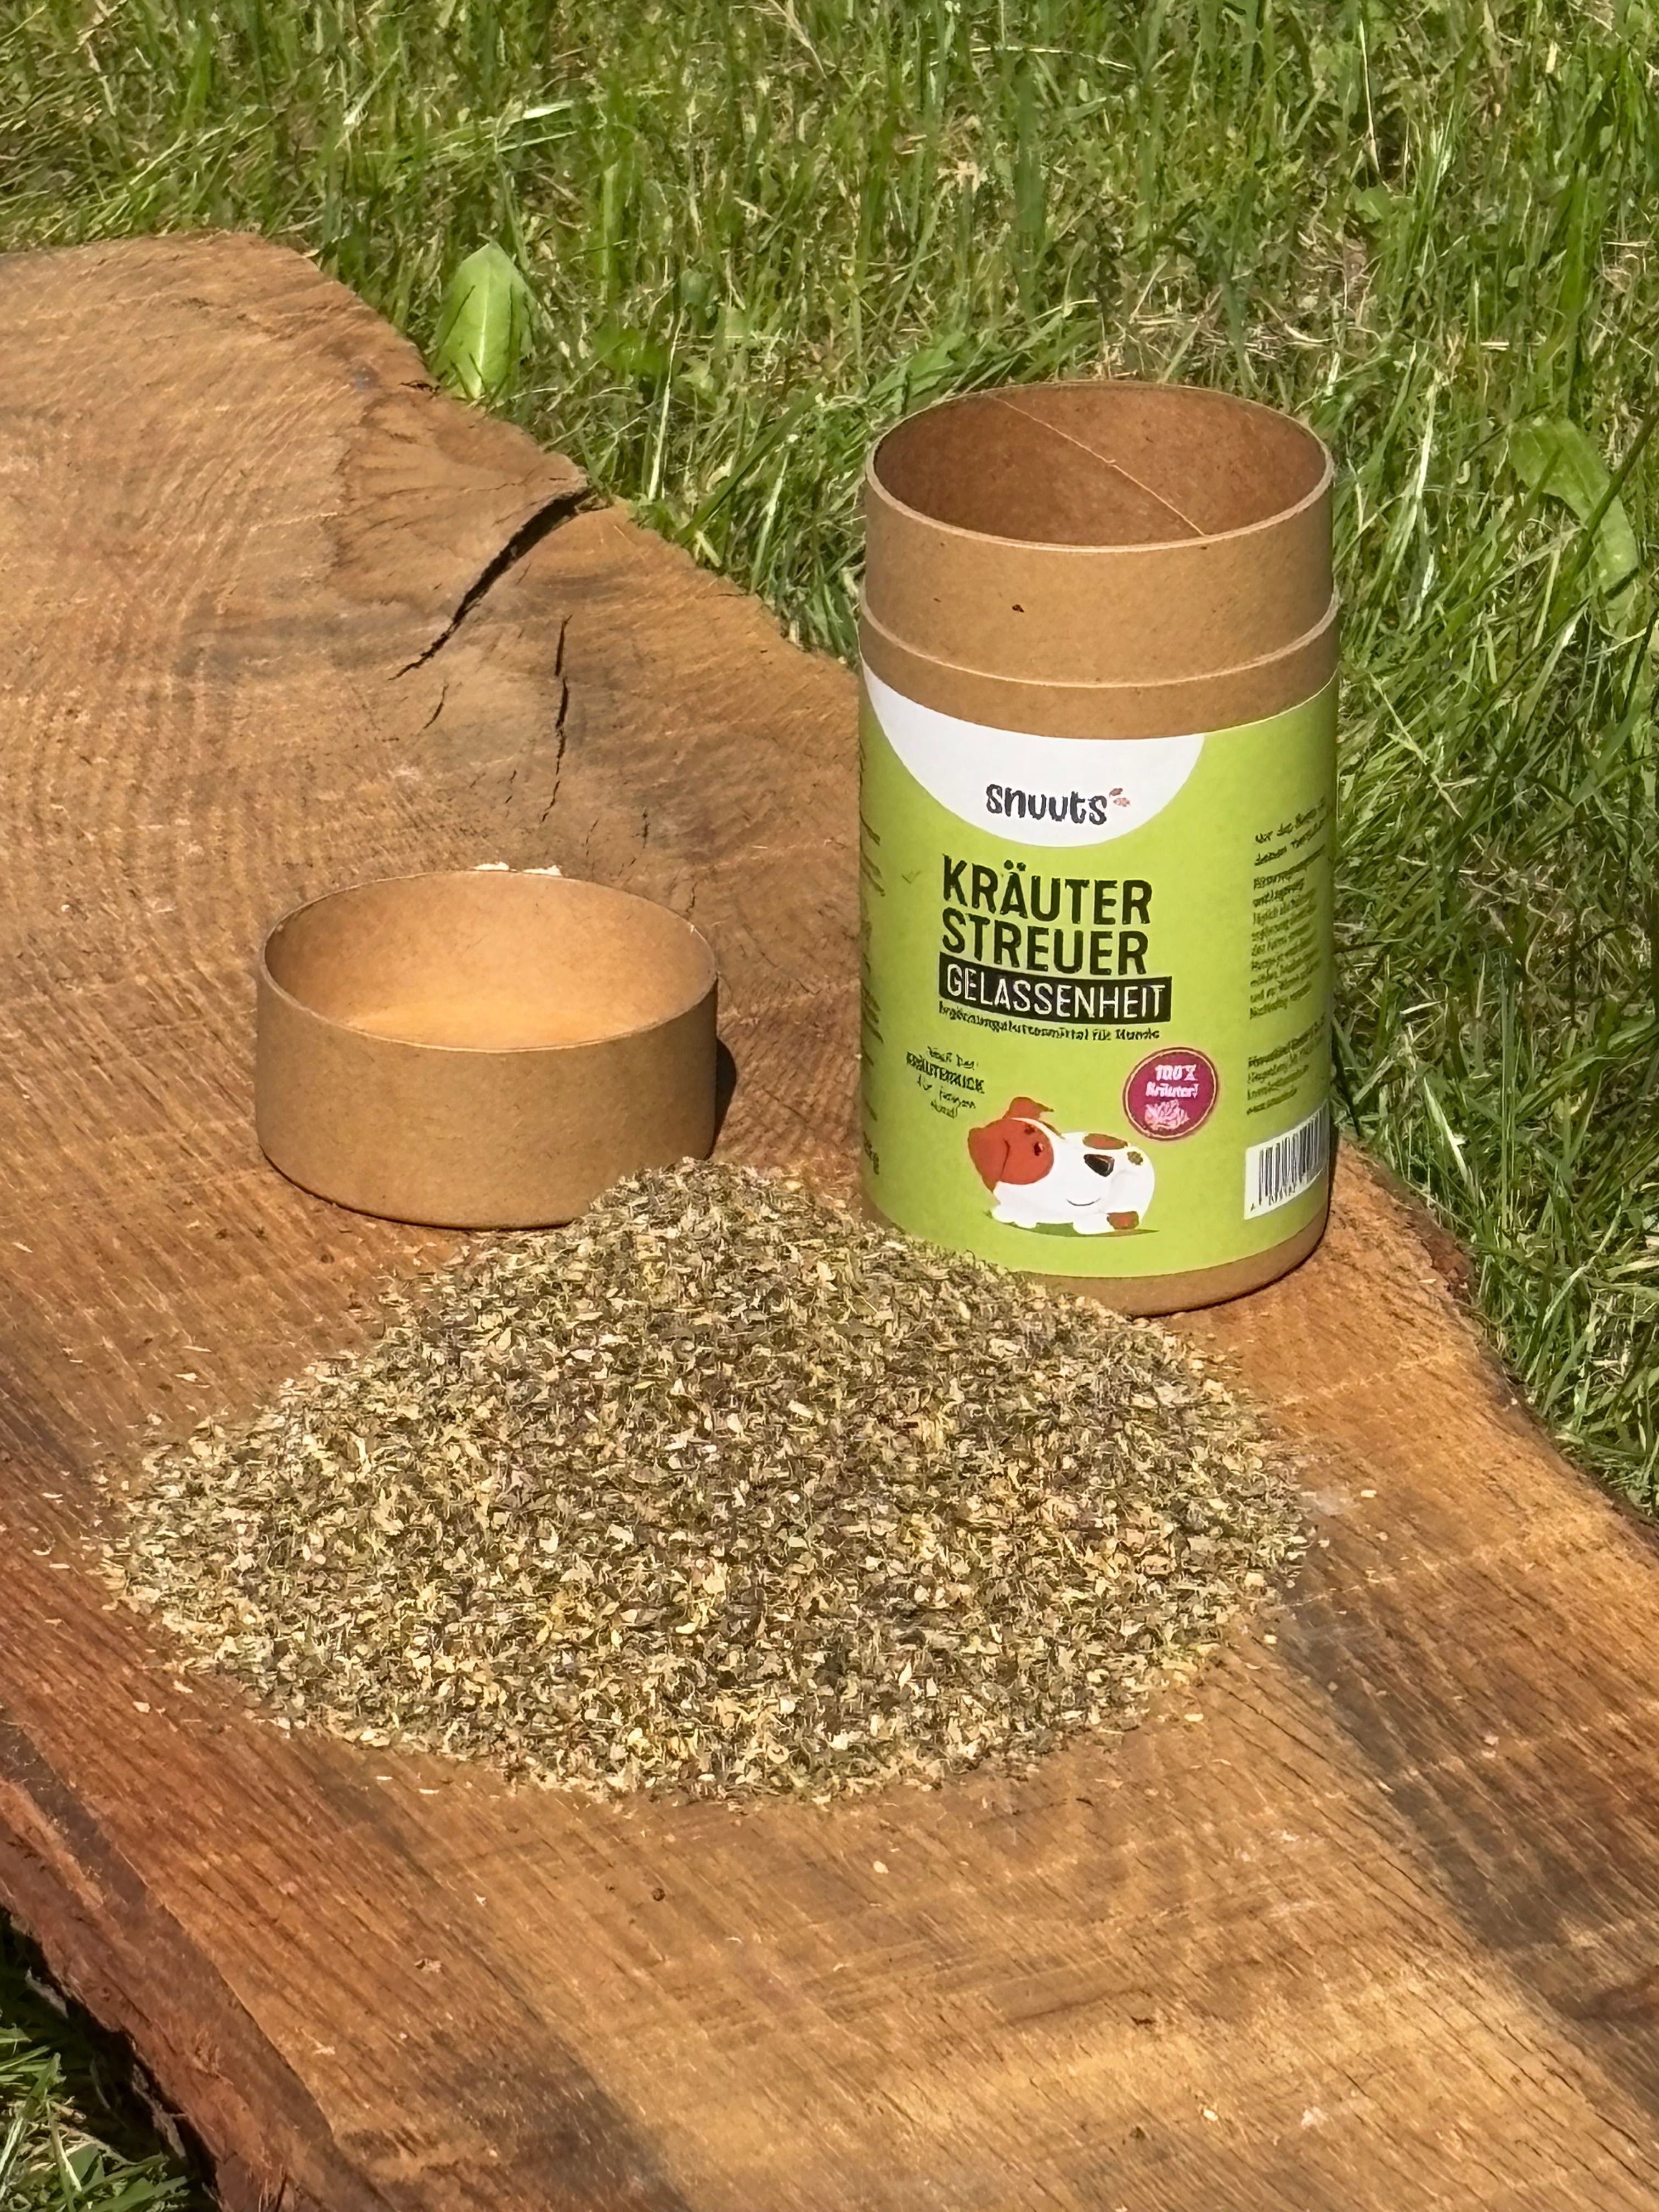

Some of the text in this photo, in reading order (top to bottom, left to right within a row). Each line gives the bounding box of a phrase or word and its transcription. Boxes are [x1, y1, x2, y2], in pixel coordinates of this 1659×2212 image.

[986, 783, 1107, 825] snuuts
[941, 853, 1153, 926] KRÄUTER
[941, 907, 1148, 976] STREUER
[946, 963, 1166, 1019] GELASSENHEIT
